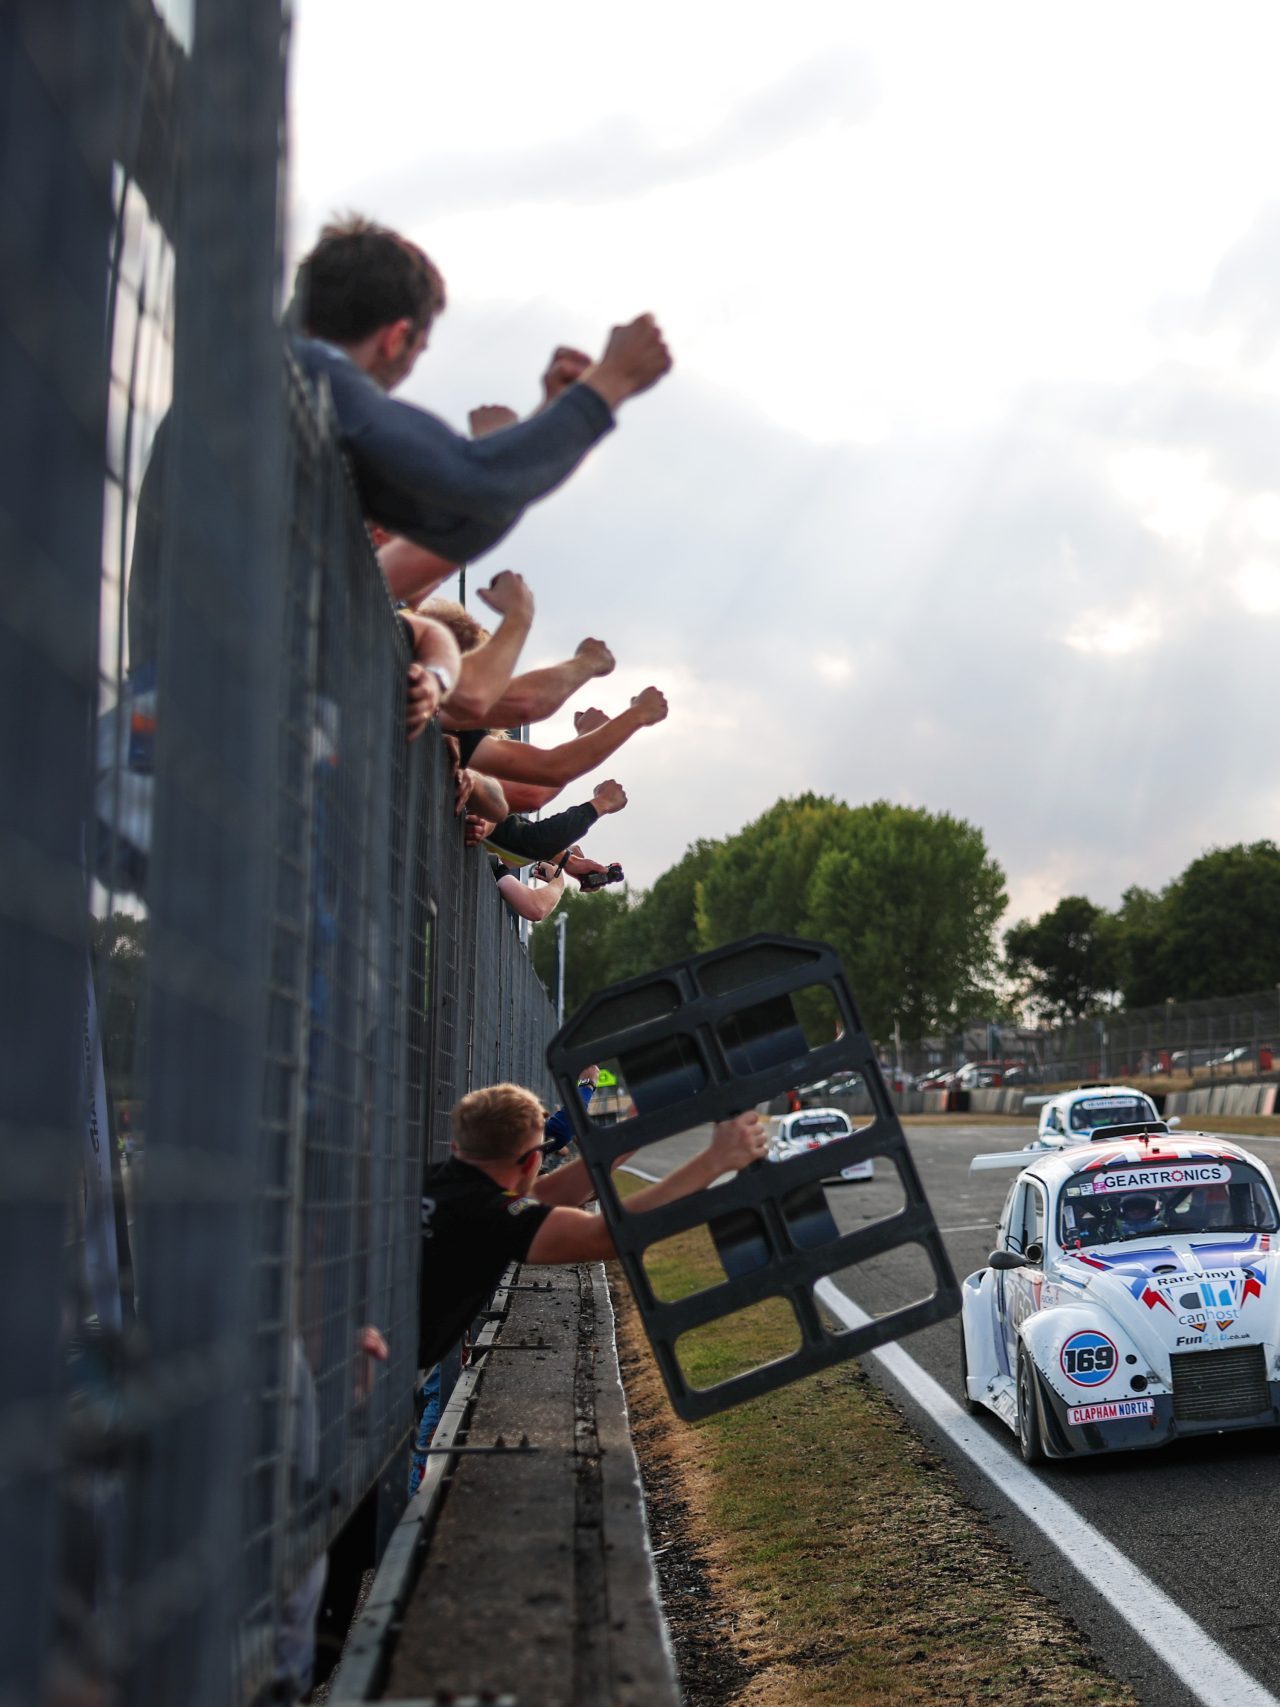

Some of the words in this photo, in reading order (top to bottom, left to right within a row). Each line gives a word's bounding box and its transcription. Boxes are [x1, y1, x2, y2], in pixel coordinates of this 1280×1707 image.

[1104, 1168, 1221, 1188] GEARTRONICS
[1157, 1270, 1236, 1286] RareVinyl
[1178, 1308, 1240, 1325] canhost
[1065, 1345, 1114, 1374] 169
[1073, 1405, 1118, 1422] CLAPHAM
[1118, 1402, 1149, 1416] NORTH
